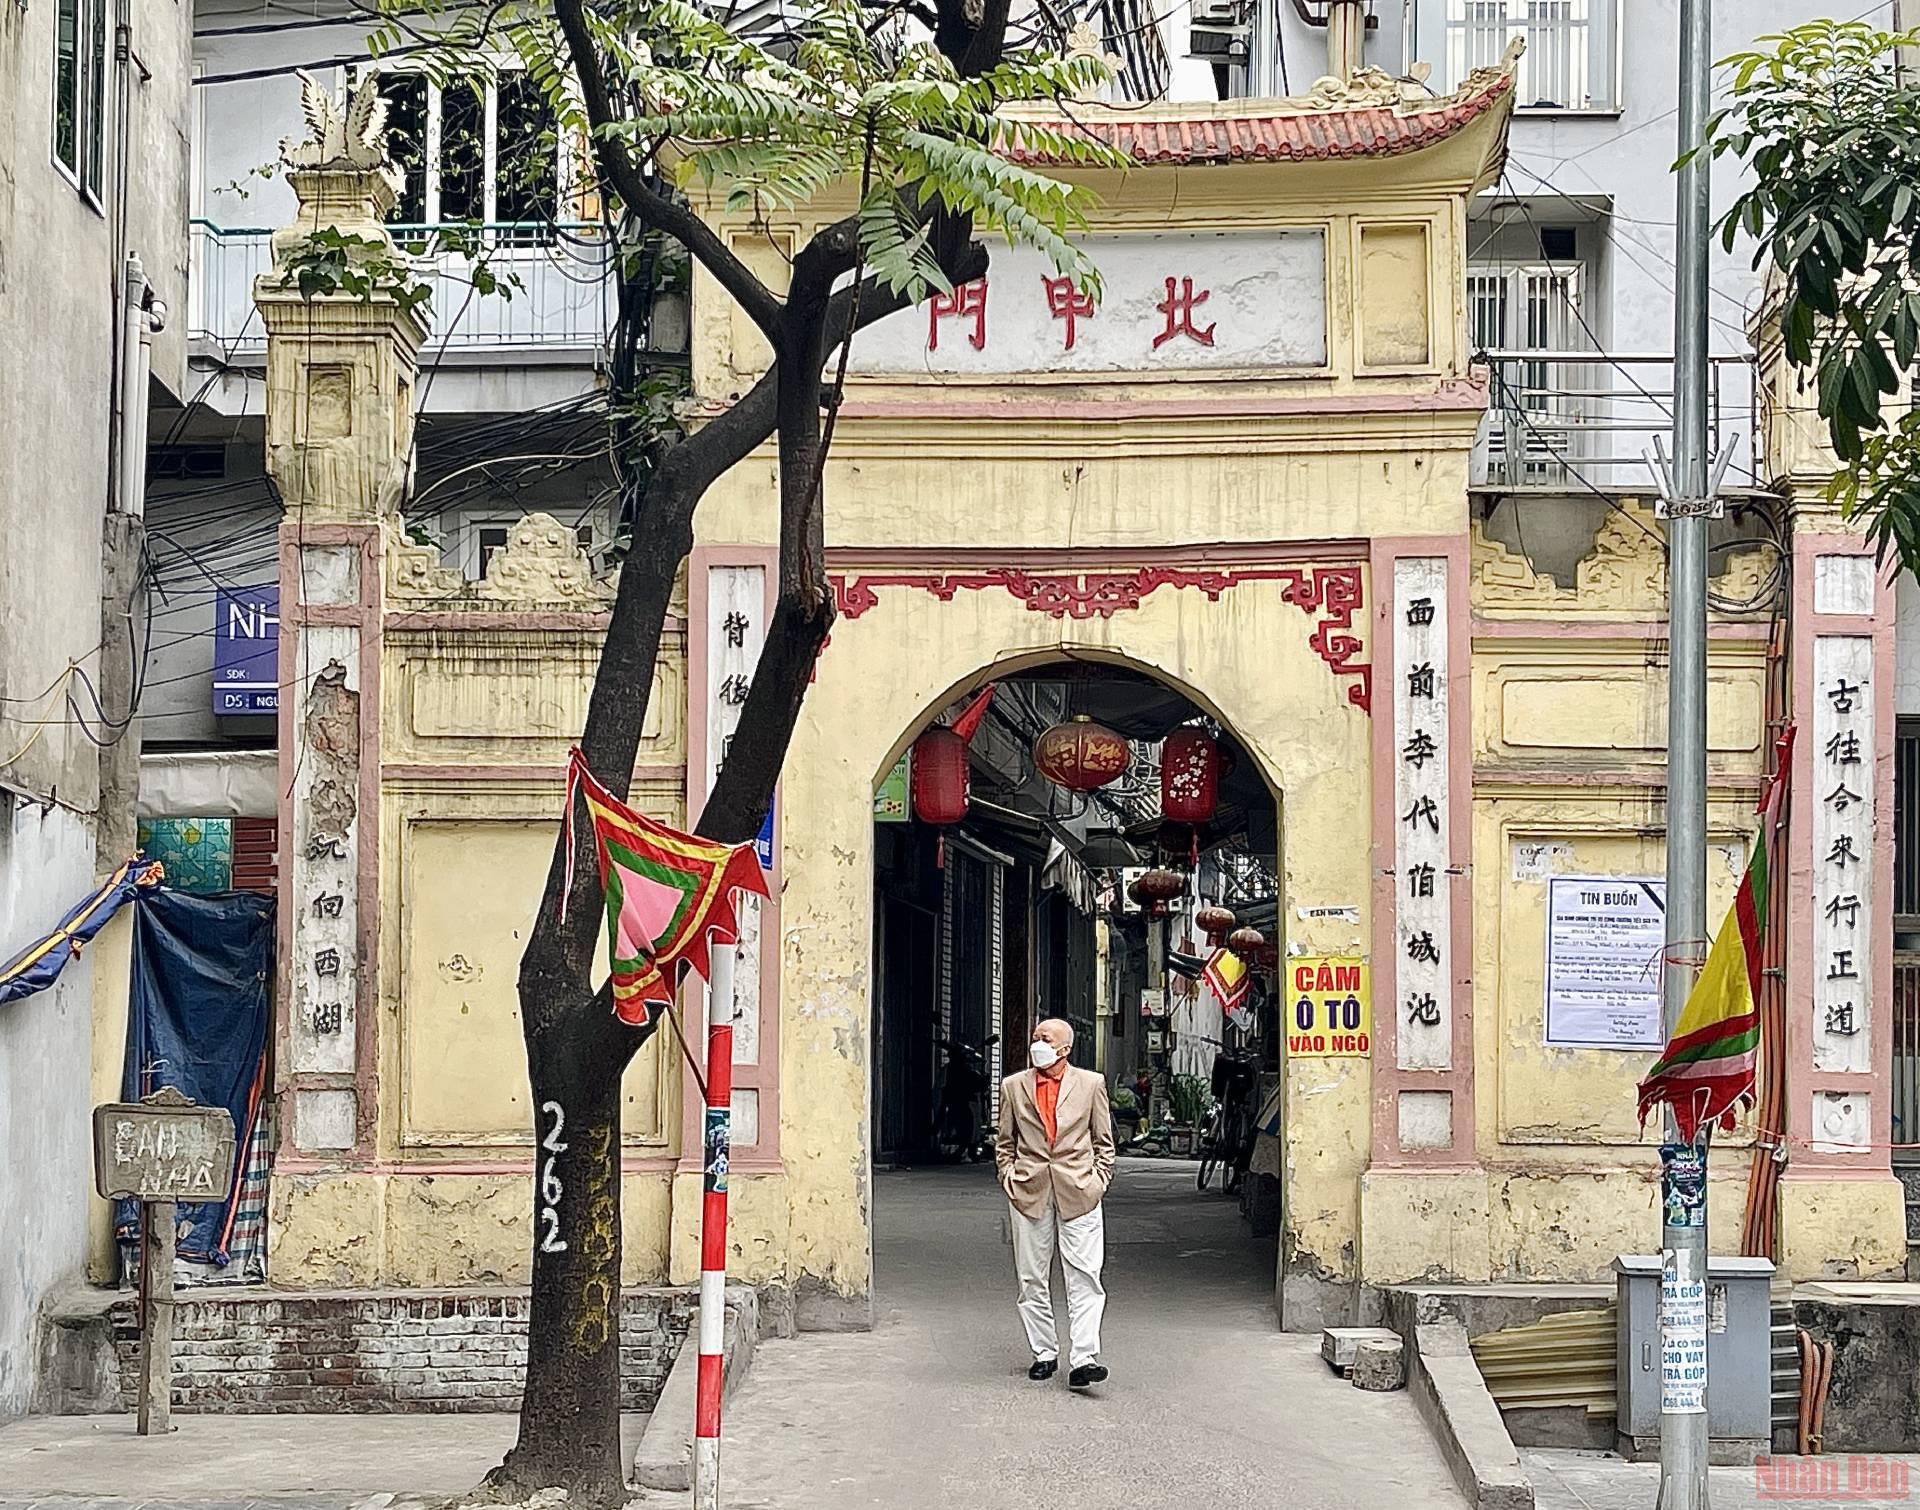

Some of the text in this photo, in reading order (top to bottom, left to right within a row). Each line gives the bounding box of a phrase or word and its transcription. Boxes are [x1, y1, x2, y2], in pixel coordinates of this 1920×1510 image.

[1580, 892, 1600, 905] TIN
[1295, 957, 1361, 992] CẤM
[1296, 994, 1361, 1031] Ô TÔ
[1289, 1033, 1369, 1052] VÀO NGÕ
[1663, 1351, 1704, 1363] CHO VAY
